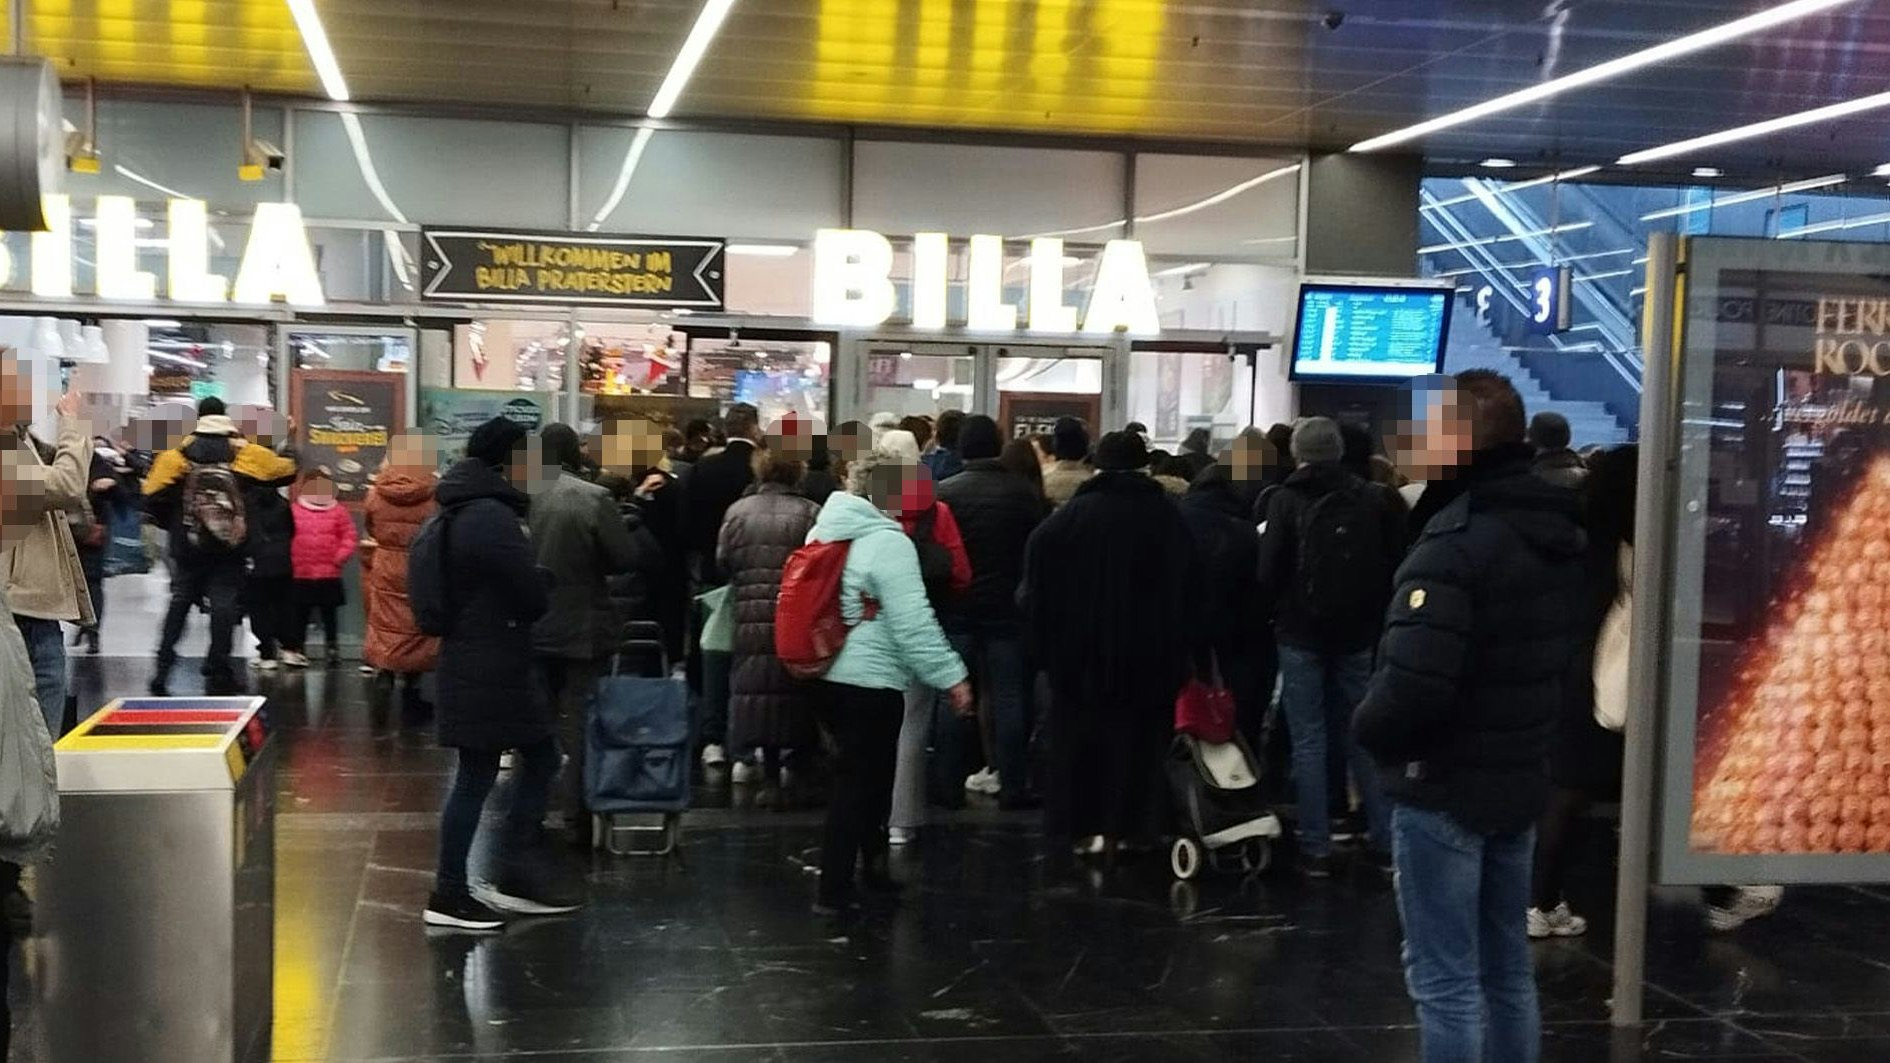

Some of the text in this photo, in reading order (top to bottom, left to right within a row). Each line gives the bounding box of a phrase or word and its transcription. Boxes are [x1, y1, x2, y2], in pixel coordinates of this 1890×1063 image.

[0, 193, 325, 305] ILLA
[478, 241, 673, 272] WILLKOMMEN IM
[476, 265, 673, 294] BILLA PRATERSTERN
[812, 229, 1160, 333] BILLA
[1534, 277, 1552, 323] 3
